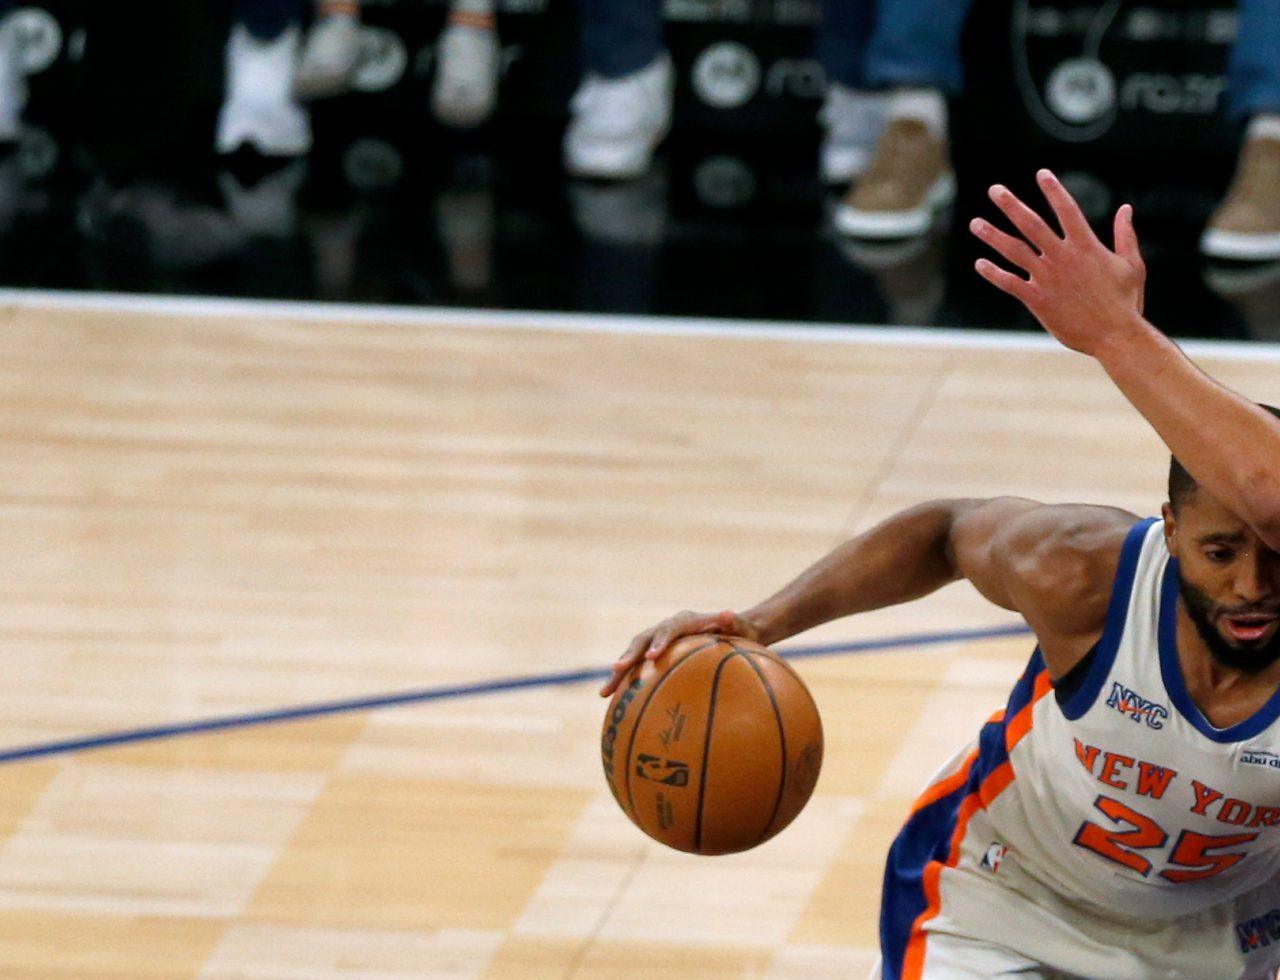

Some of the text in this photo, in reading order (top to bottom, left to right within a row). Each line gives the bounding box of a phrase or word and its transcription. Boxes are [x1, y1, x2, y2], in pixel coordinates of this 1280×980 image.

[1106, 682, 1169, 730] NYC
[1074, 738, 1178, 800] NEW
[1072, 795, 1261, 884] 25
